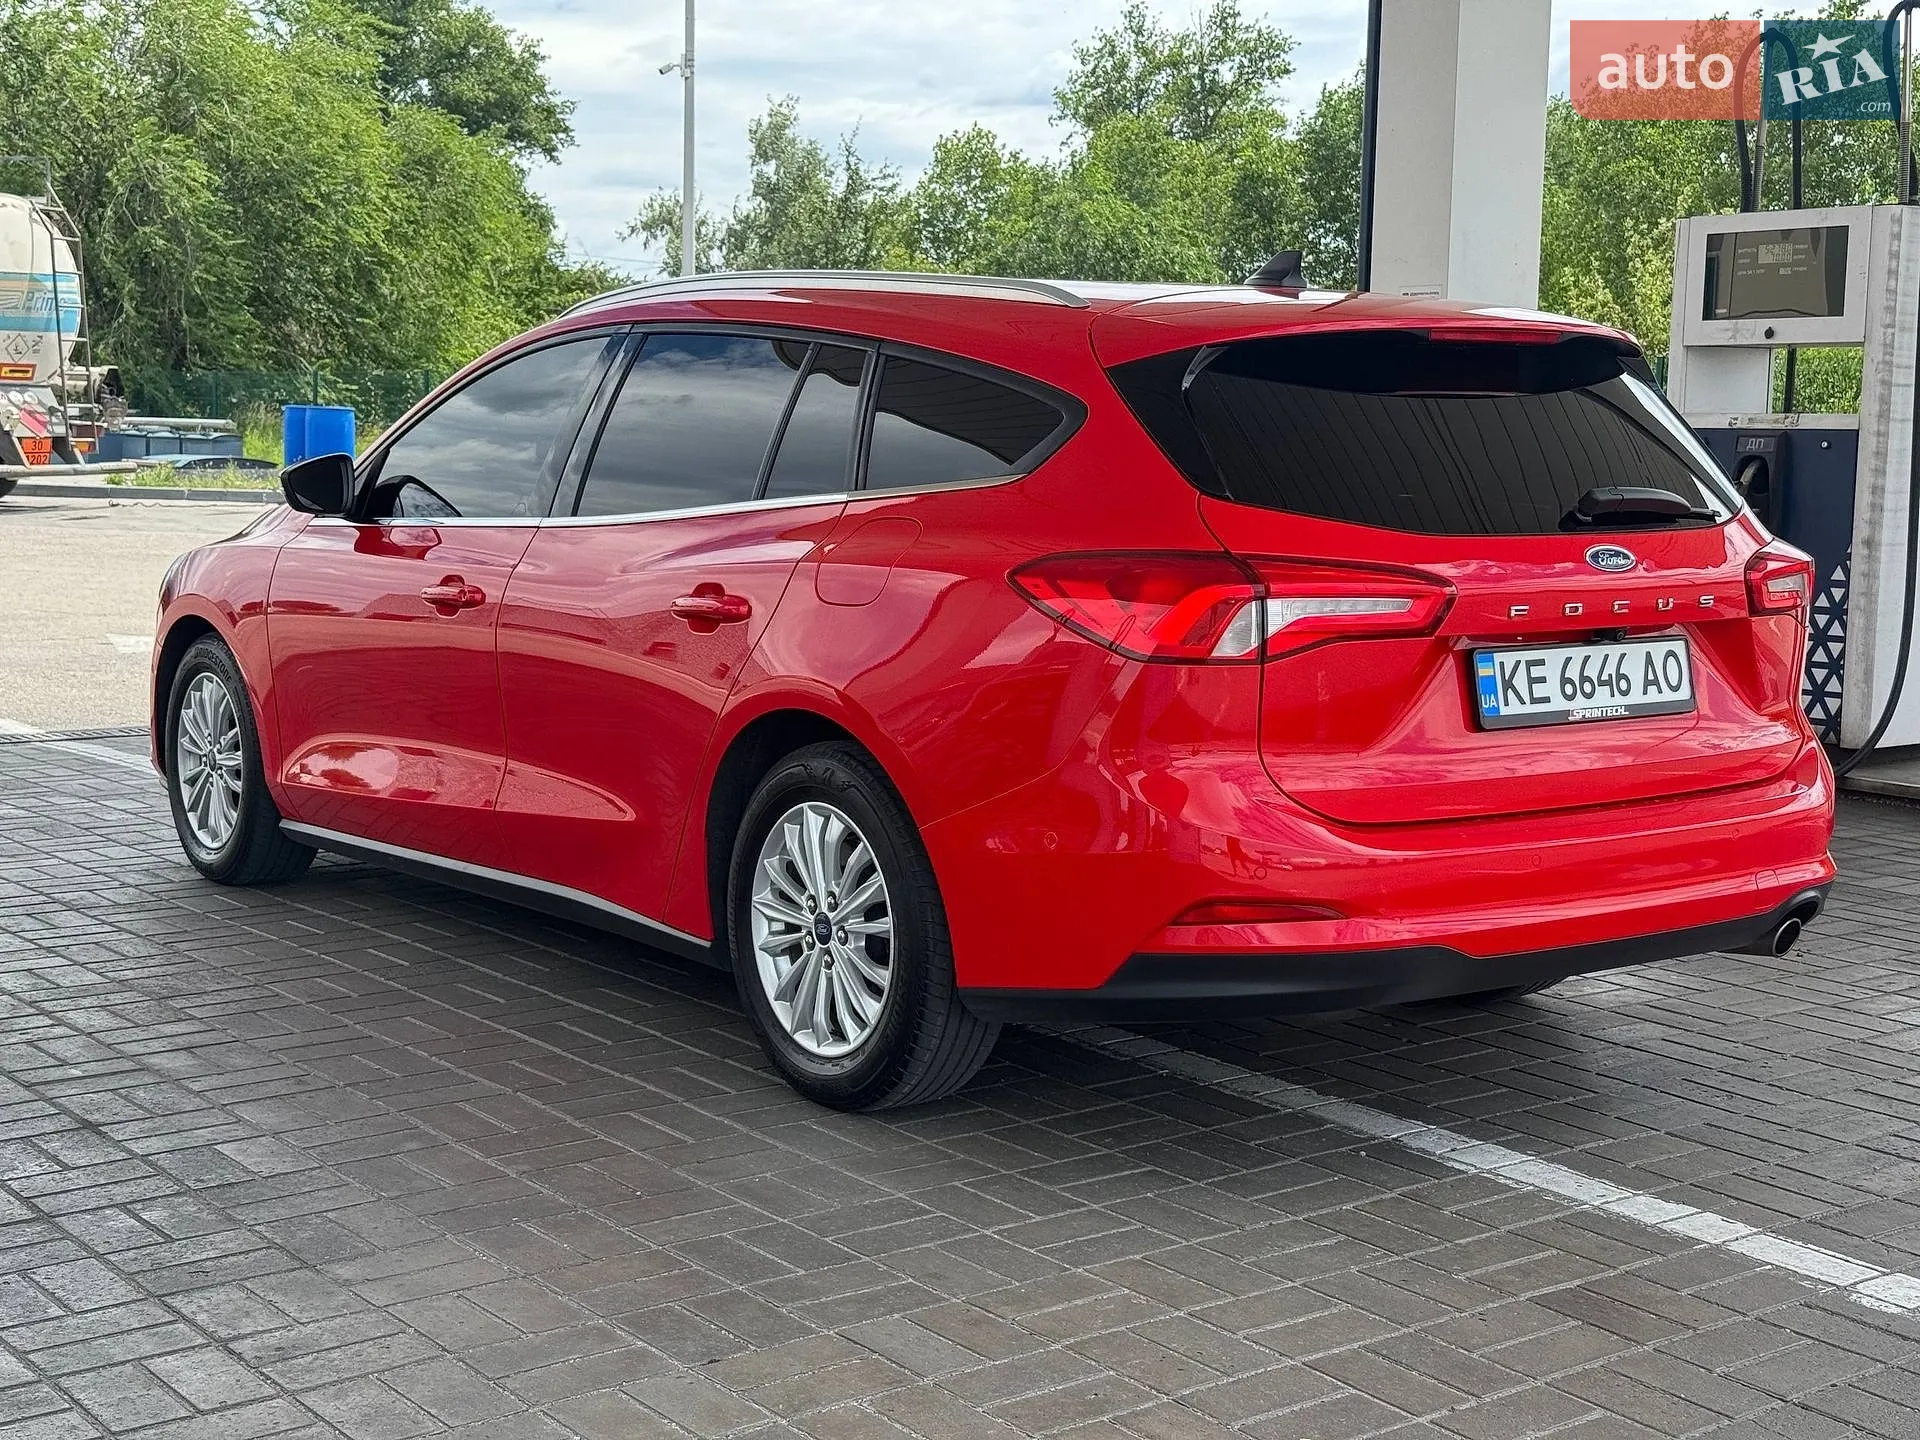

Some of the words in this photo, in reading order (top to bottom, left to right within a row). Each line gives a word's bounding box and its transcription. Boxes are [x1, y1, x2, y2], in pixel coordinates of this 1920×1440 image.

[31, 440, 43, 451] 30
[1747, 438, 1764, 451] ДП
[1509, 594, 1715, 618] FOCUS
[1498, 657, 1552, 707] KE
[1559, 651, 1632, 702] 6646
[1642, 648, 1684, 696] AO
[1481, 693, 1498, 709] UA
